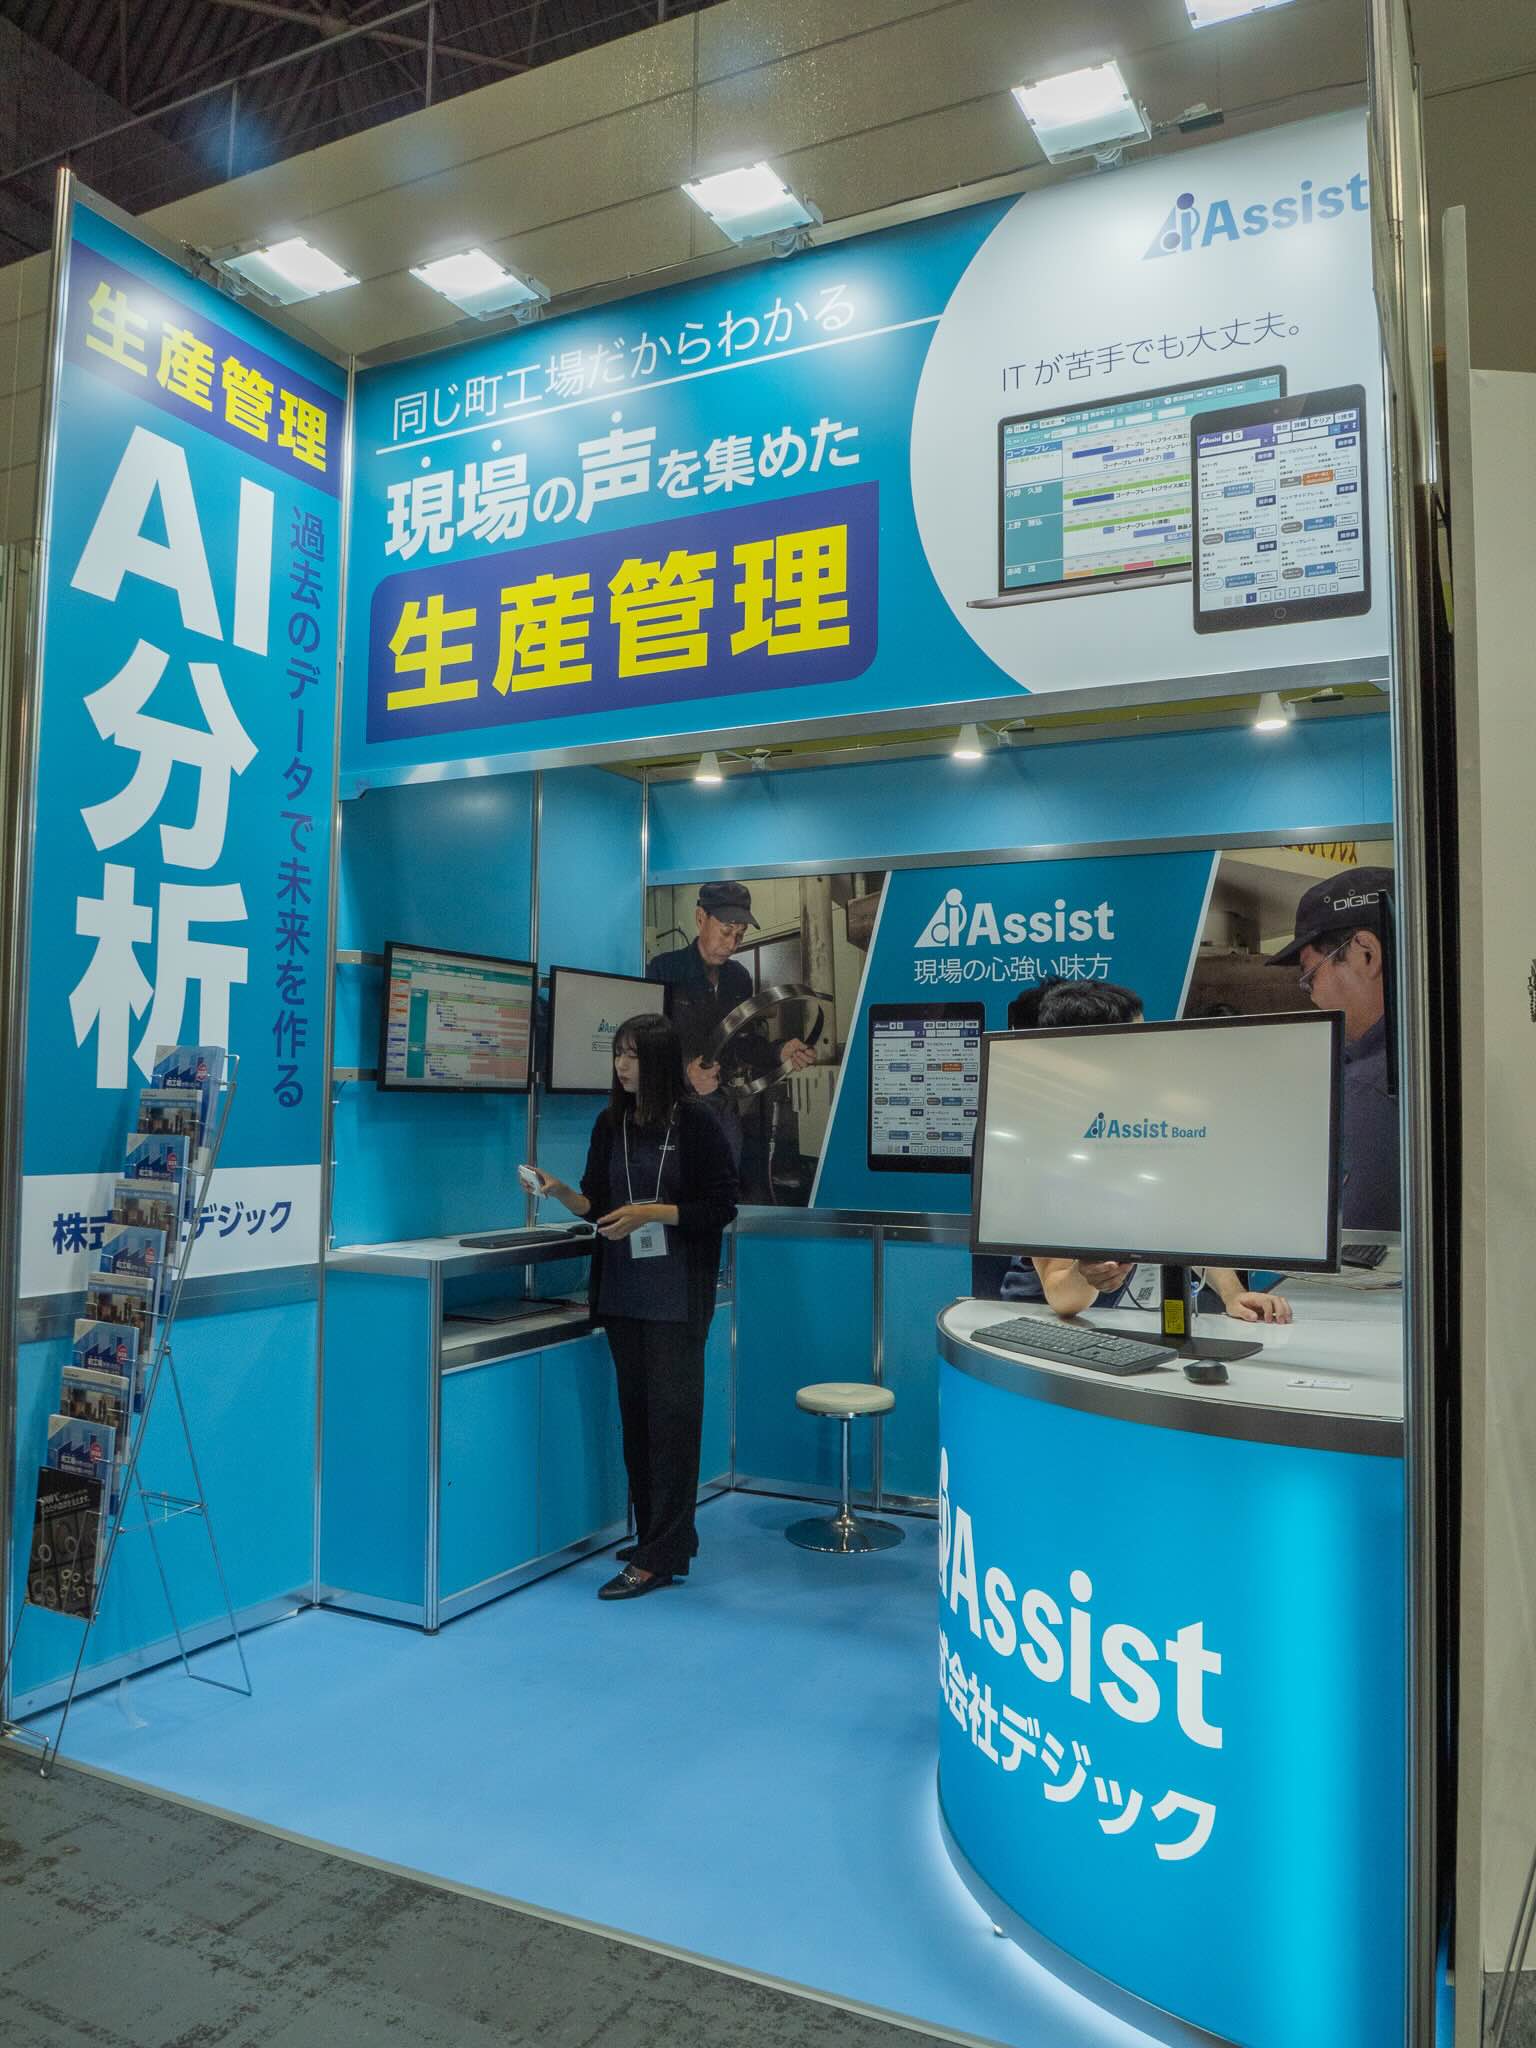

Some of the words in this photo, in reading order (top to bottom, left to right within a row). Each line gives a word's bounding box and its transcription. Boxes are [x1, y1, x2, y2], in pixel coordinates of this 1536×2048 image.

[86, 281, 327, 473] 生産管理
[393, 284, 856, 440] 同じ町工場だからわかる
[384, 414, 860, 561] 現場の声を集めた
[387, 524, 850, 711] 生産管理
[273, 506, 325, 1108] 過去のデータで未来を作る
[914, 953, 1112, 985] 現場の心強い味方
[1107, 1118, 1169, 1138] Assist
[1171, 1126, 1207, 1138] Board
